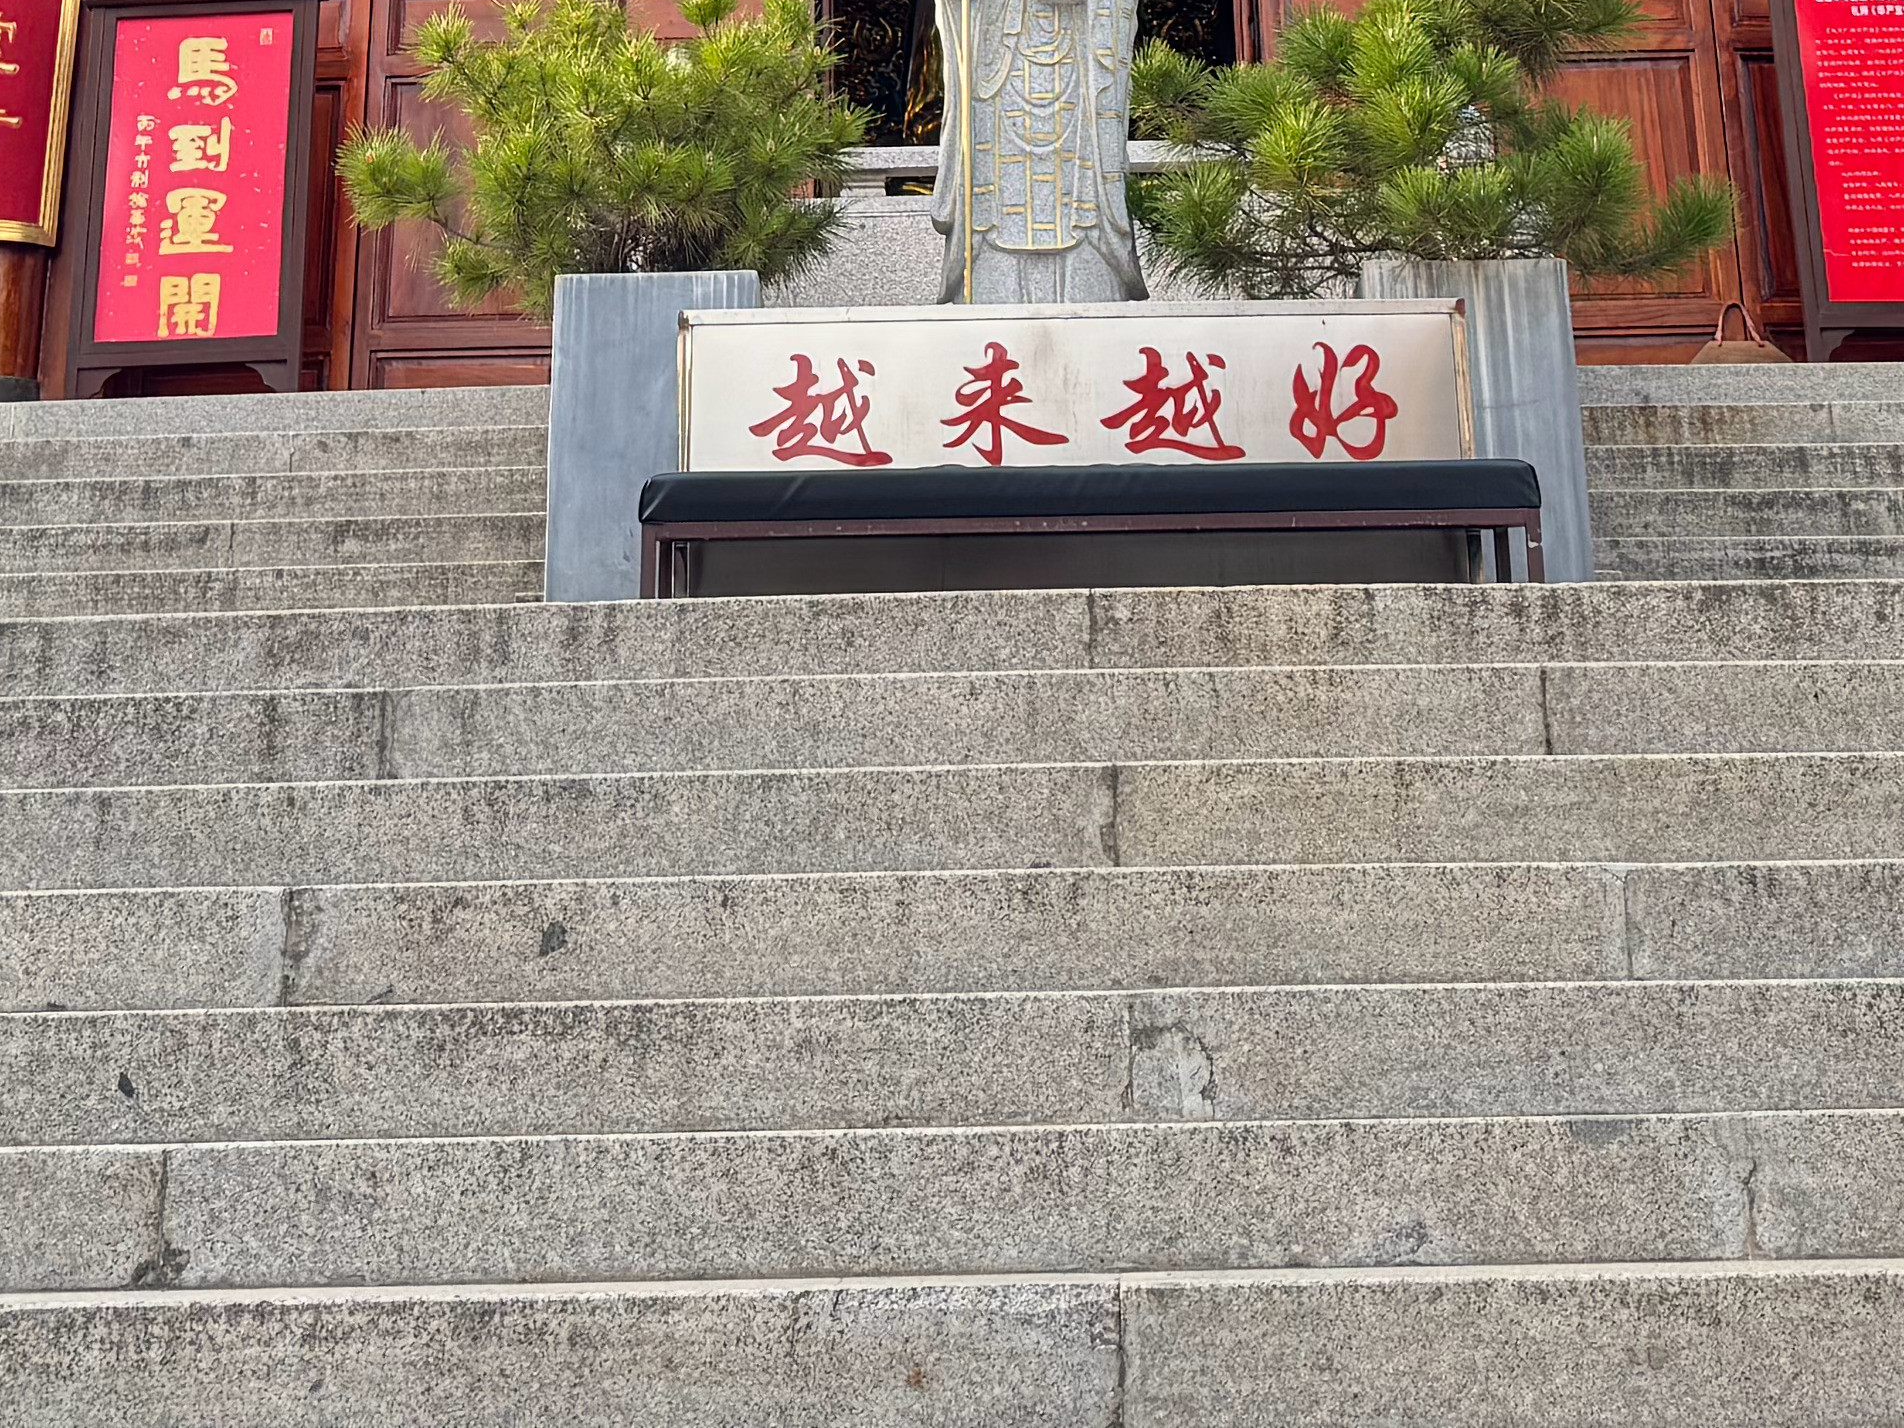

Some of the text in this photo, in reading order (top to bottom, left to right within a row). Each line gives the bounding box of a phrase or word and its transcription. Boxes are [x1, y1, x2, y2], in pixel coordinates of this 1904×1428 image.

[158, 36, 238, 338] 馬到運開
[749, 341, 1399, 467] 越来越好
